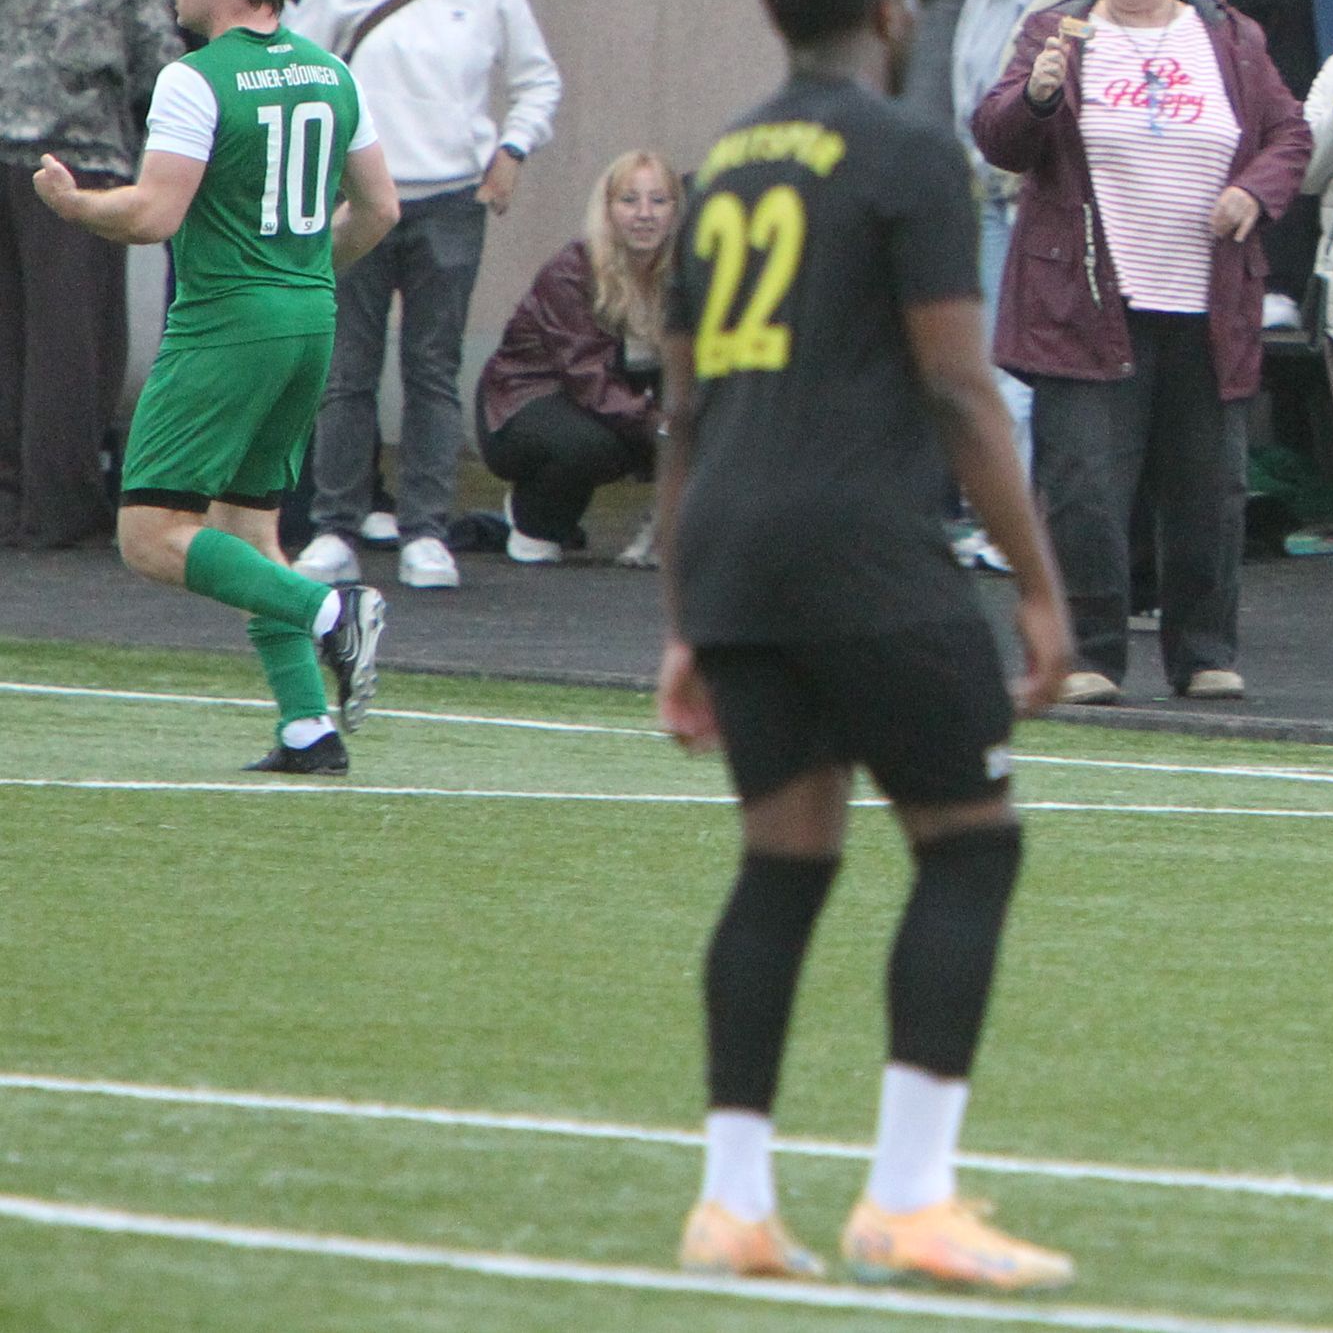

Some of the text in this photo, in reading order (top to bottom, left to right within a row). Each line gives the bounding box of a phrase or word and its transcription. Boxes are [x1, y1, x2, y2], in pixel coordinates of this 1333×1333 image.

[235, 62, 340, 92] ALLNER-BÖDINGEN
[256, 100, 335, 236] 10
[694, 181, 807, 379] 22
